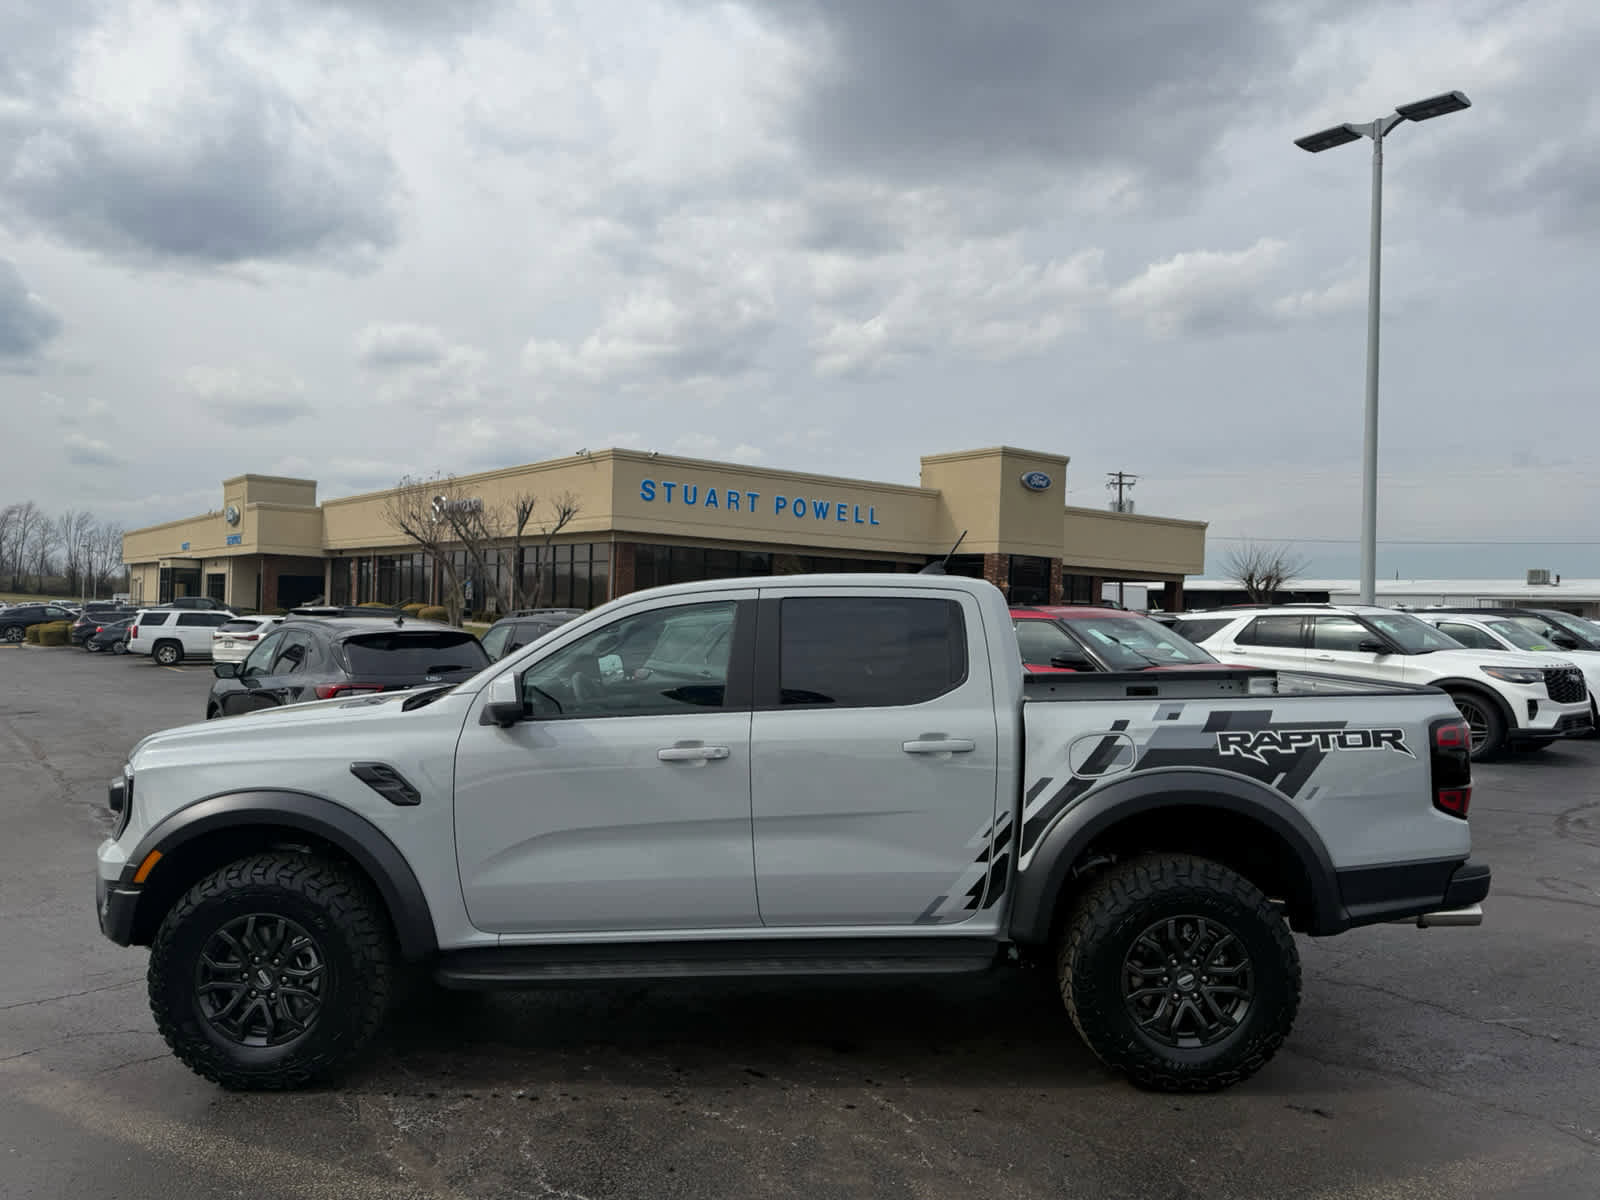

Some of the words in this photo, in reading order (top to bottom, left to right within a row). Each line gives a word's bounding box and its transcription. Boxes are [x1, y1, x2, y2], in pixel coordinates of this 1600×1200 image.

[640, 479, 760, 513] STUART
[774, 495, 880, 525] POWELL
[1216, 728, 1417, 766] RAPTOR
